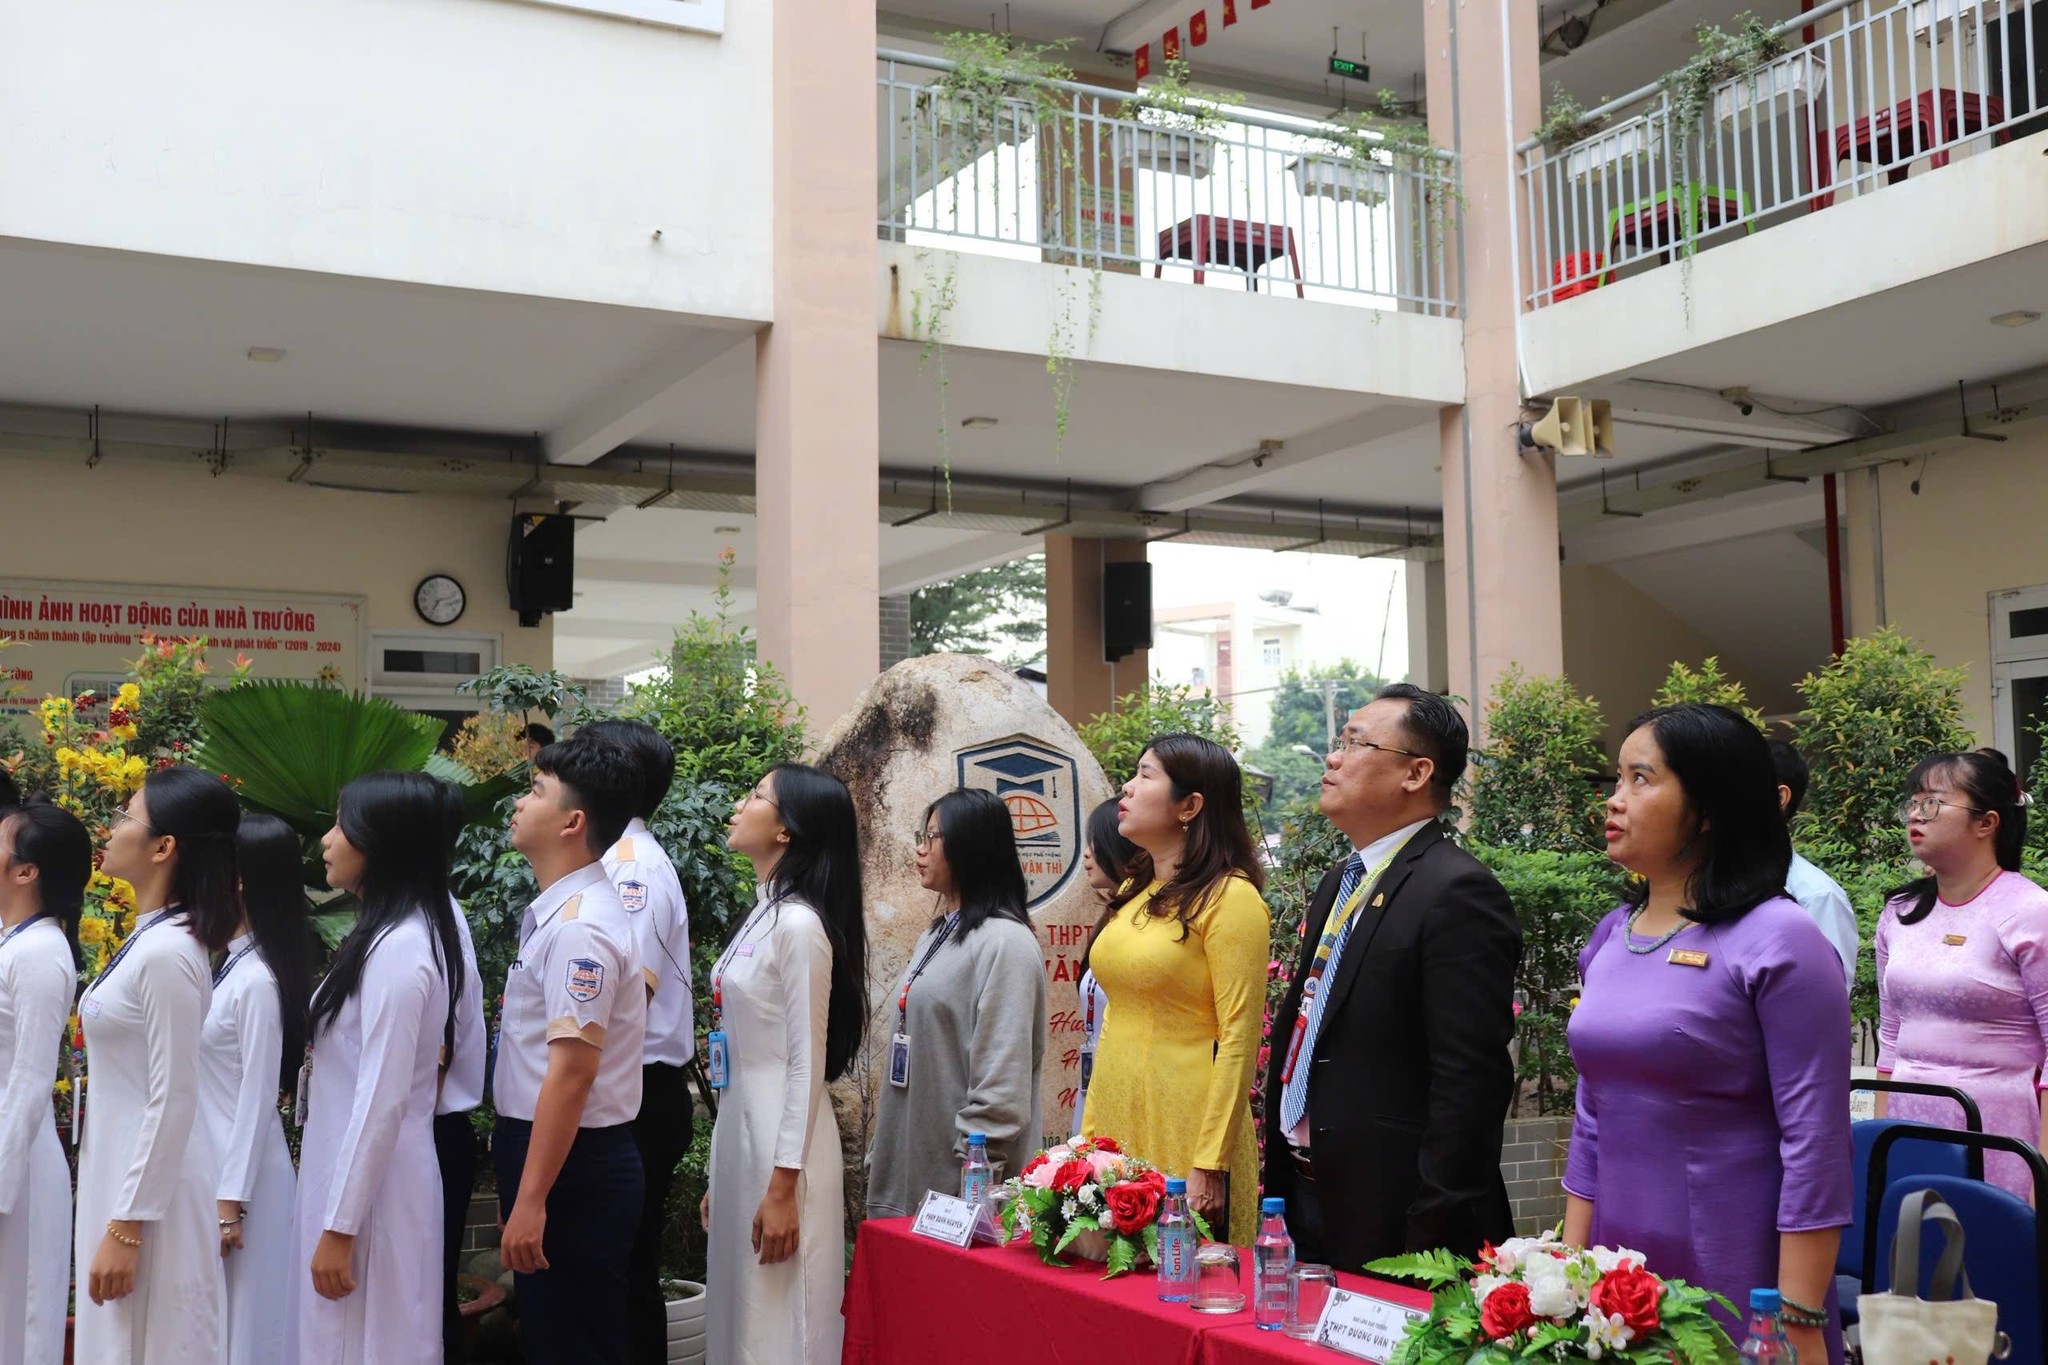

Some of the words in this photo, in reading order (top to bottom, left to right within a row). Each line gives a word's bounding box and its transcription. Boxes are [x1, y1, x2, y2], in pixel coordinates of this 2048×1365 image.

[38, 595, 73, 622] ẢNH
[79, 603, 122, 628] HOẠT
[127, 601, 172, 629] ĐỘNG
[177, 602, 209, 628] CỦA
[214, 606, 247, 630] NHÀ
[252, 606, 315, 632] TRƯỜNG
[19, 629, 25, 641] 5
[28, 629, 49, 641] năm
[52, 629, 79, 642] thành
[81, 631, 97, 645] lập
[100, 632, 132, 645] trường
[221, 637, 232, 648] và
[1046, 925, 1093, 946] THPT
